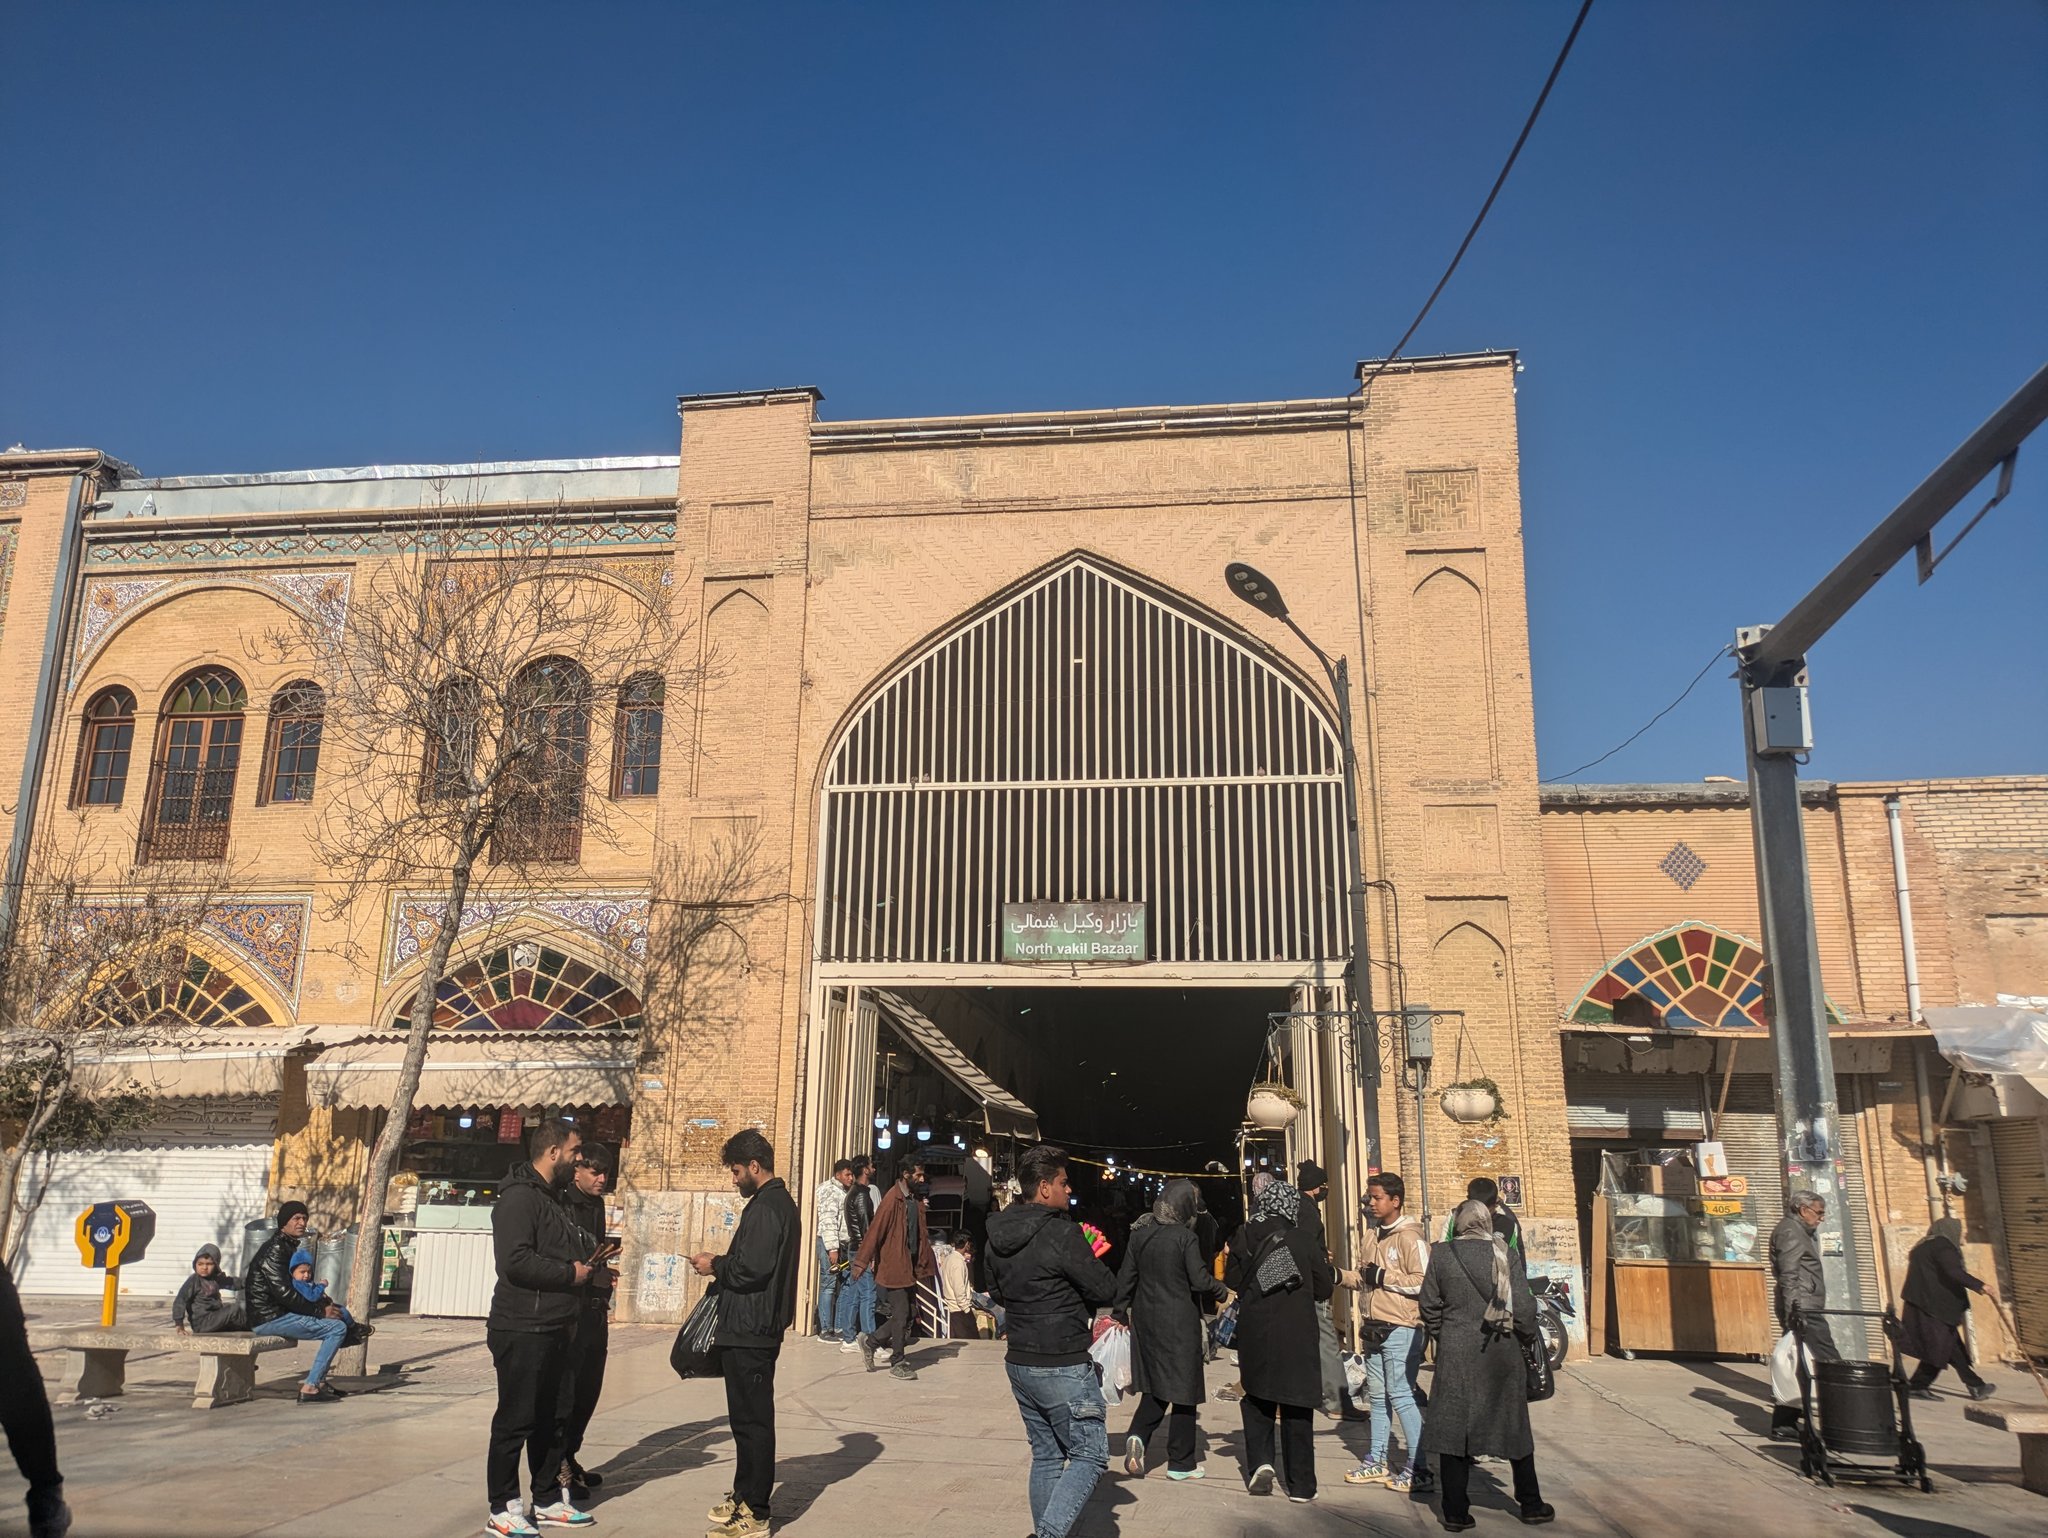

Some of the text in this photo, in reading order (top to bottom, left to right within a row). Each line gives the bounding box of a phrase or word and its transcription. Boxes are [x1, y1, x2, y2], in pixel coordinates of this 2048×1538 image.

[1011, 912, 1138, 934] بازار وکیل شمالی
[1015, 942, 1139, 955] North vakil Bazaar
[1712, 1205, 1731, 1214] 405
